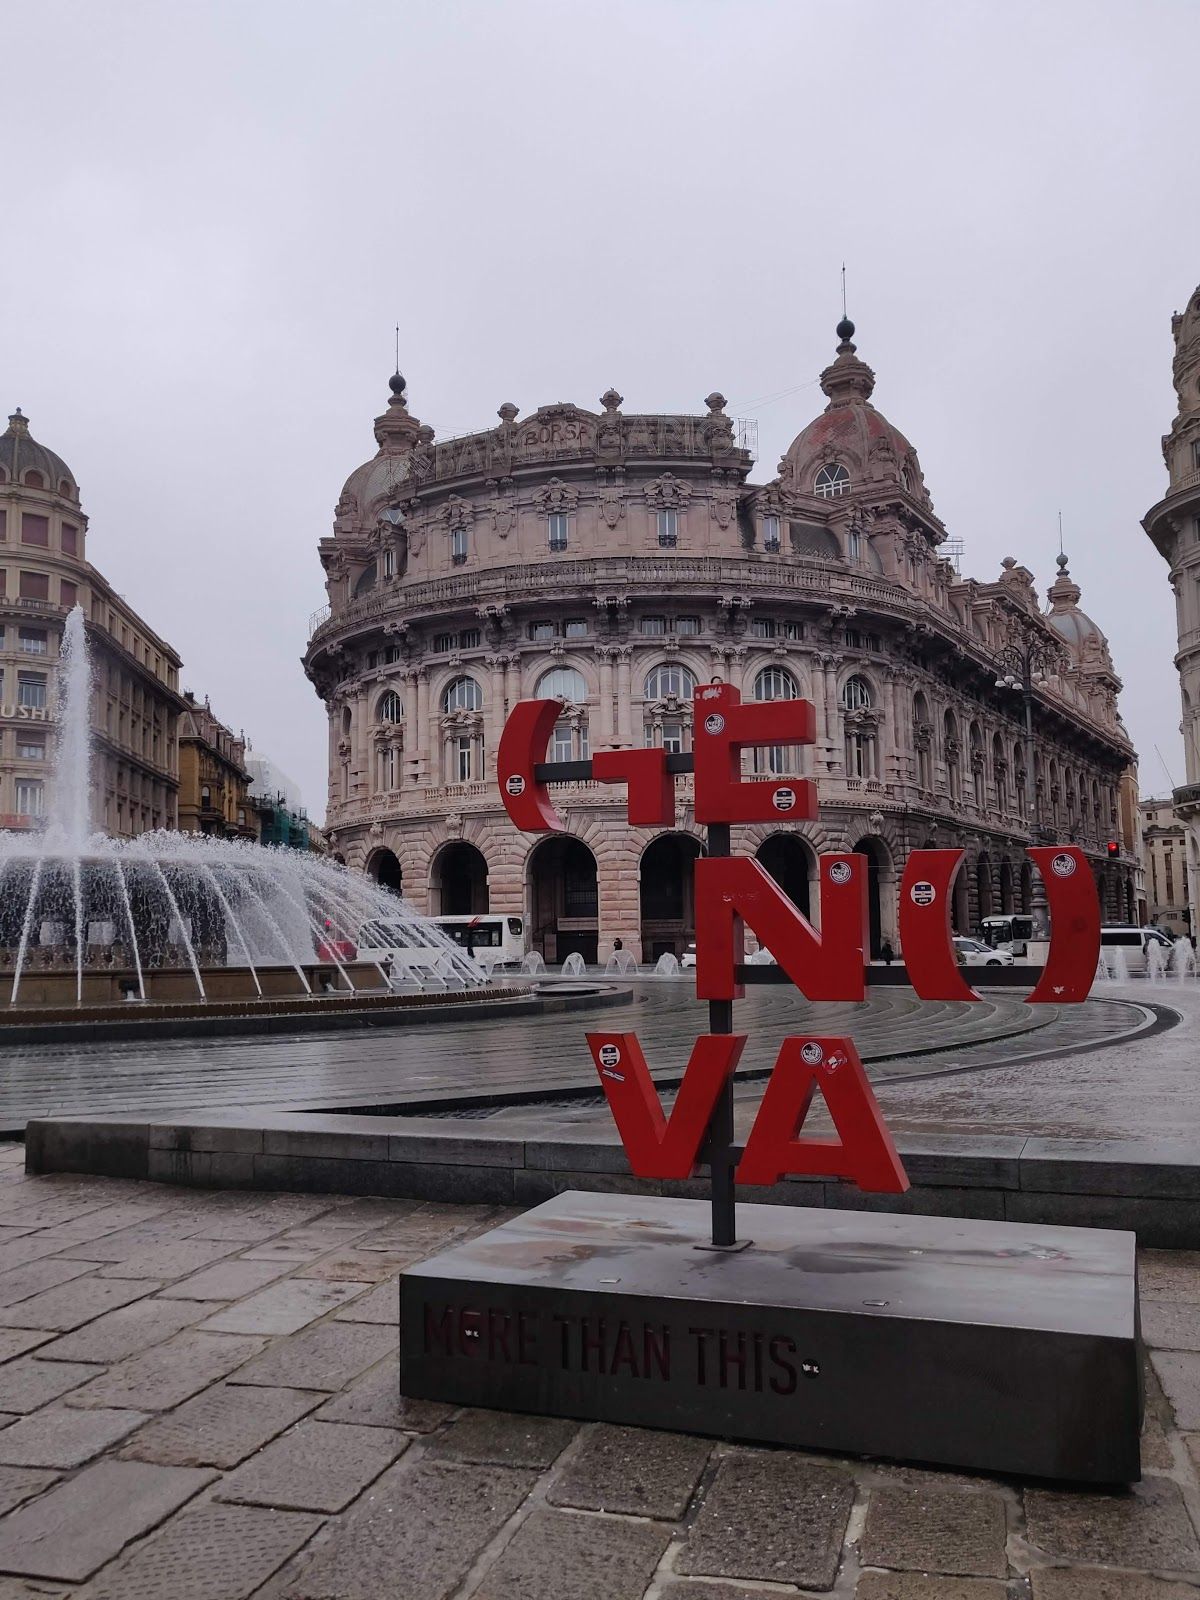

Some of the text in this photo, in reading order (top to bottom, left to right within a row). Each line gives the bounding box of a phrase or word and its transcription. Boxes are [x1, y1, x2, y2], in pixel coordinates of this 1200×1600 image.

[524, 421, 590, 446] BORSA
[585, 1031, 911, 1194] VA
[424, 1301, 799, 1396] MORE THAN THIS
